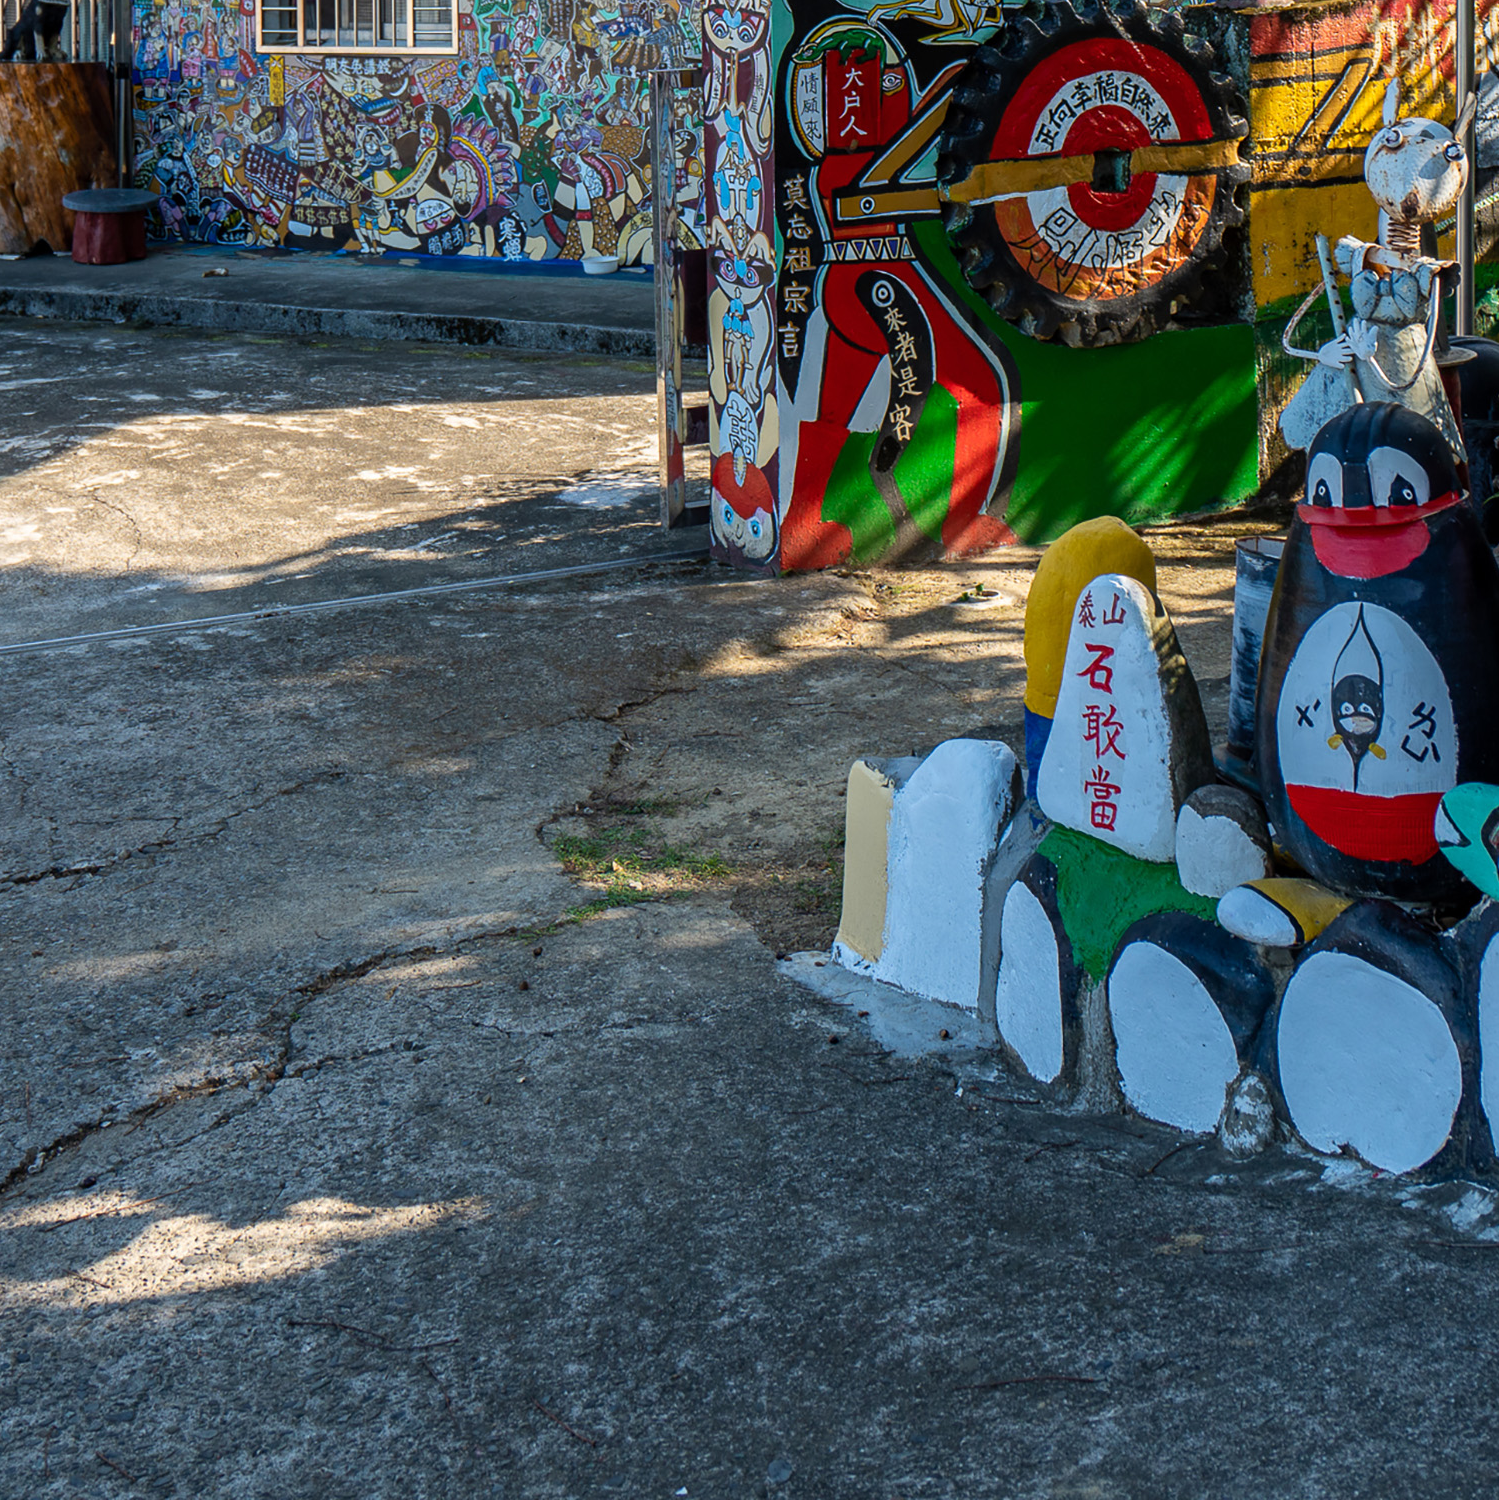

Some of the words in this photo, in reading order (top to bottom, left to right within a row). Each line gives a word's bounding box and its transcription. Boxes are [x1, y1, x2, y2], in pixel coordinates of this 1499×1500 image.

[1035, 72, 1171, 150] 正向幸福自然來
[778, 173, 817, 359] 莫忘祖宗言
[883, 306, 923, 442] 來者是客
[1078, 591, 1127, 628] 泰山
[1077, 643, 1127, 832] 石敢當
